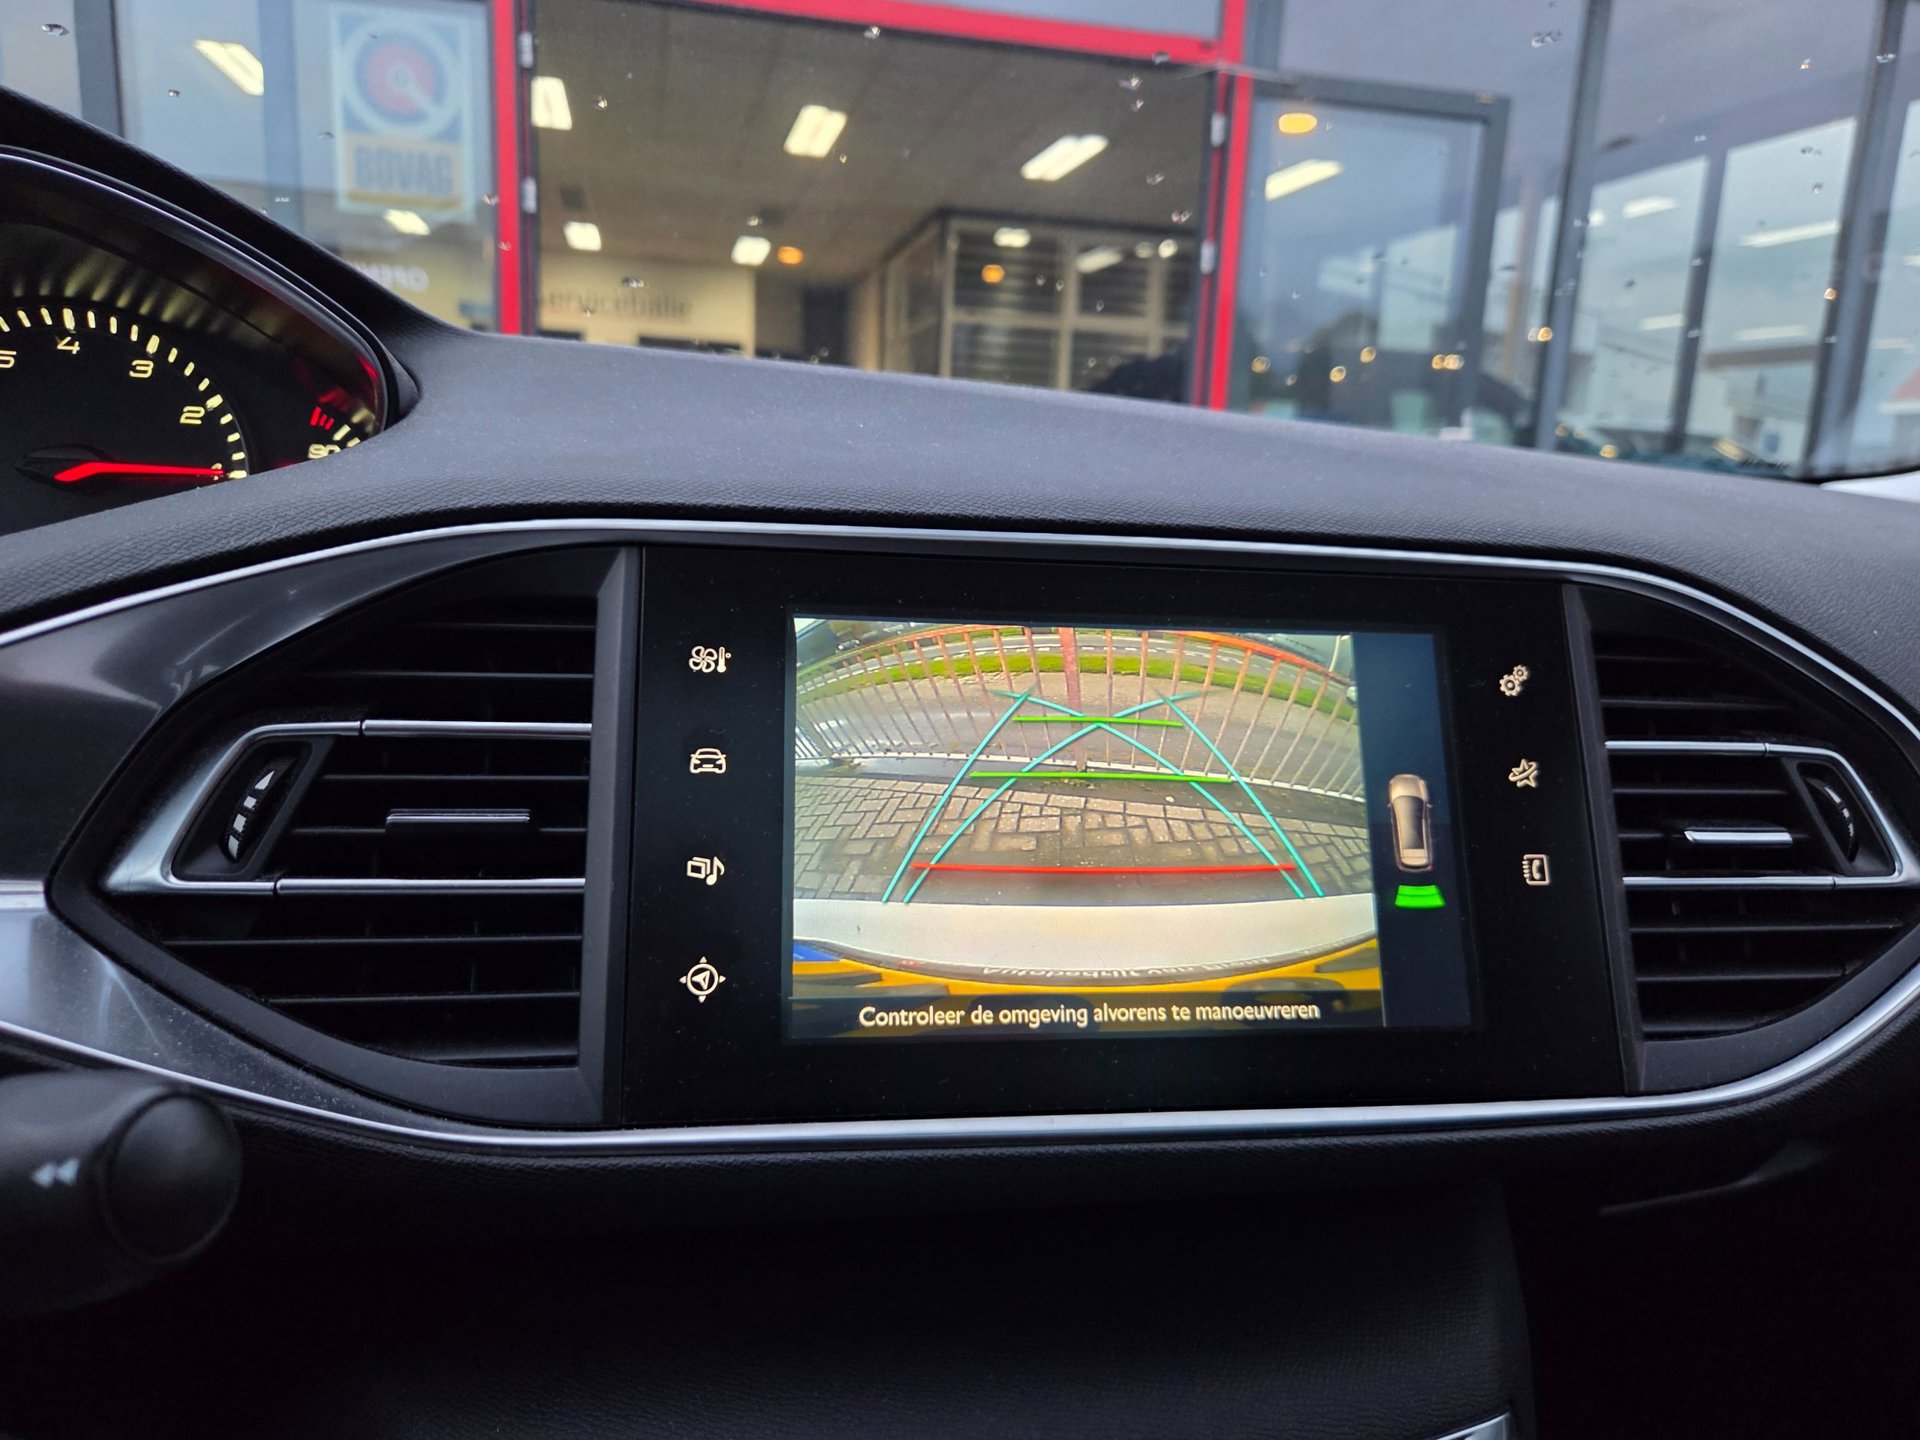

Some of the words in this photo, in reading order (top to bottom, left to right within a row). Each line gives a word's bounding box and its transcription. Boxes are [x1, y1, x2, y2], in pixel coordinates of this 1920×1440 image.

[56, 336, 81, 355] 4
[129, 359, 155, 378] 3
[179, 405, 206, 425] 2
[858, 1005, 965, 1028] Controleer
[970, 1004, 994, 1025] de
[998, 1004, 1089, 1029] omgeving
[1093, 1002, 1168, 1022] alvorens
[1171, 1004, 1192, 1021] te
[1195, 1003, 1321, 1022] manoeuvreren
